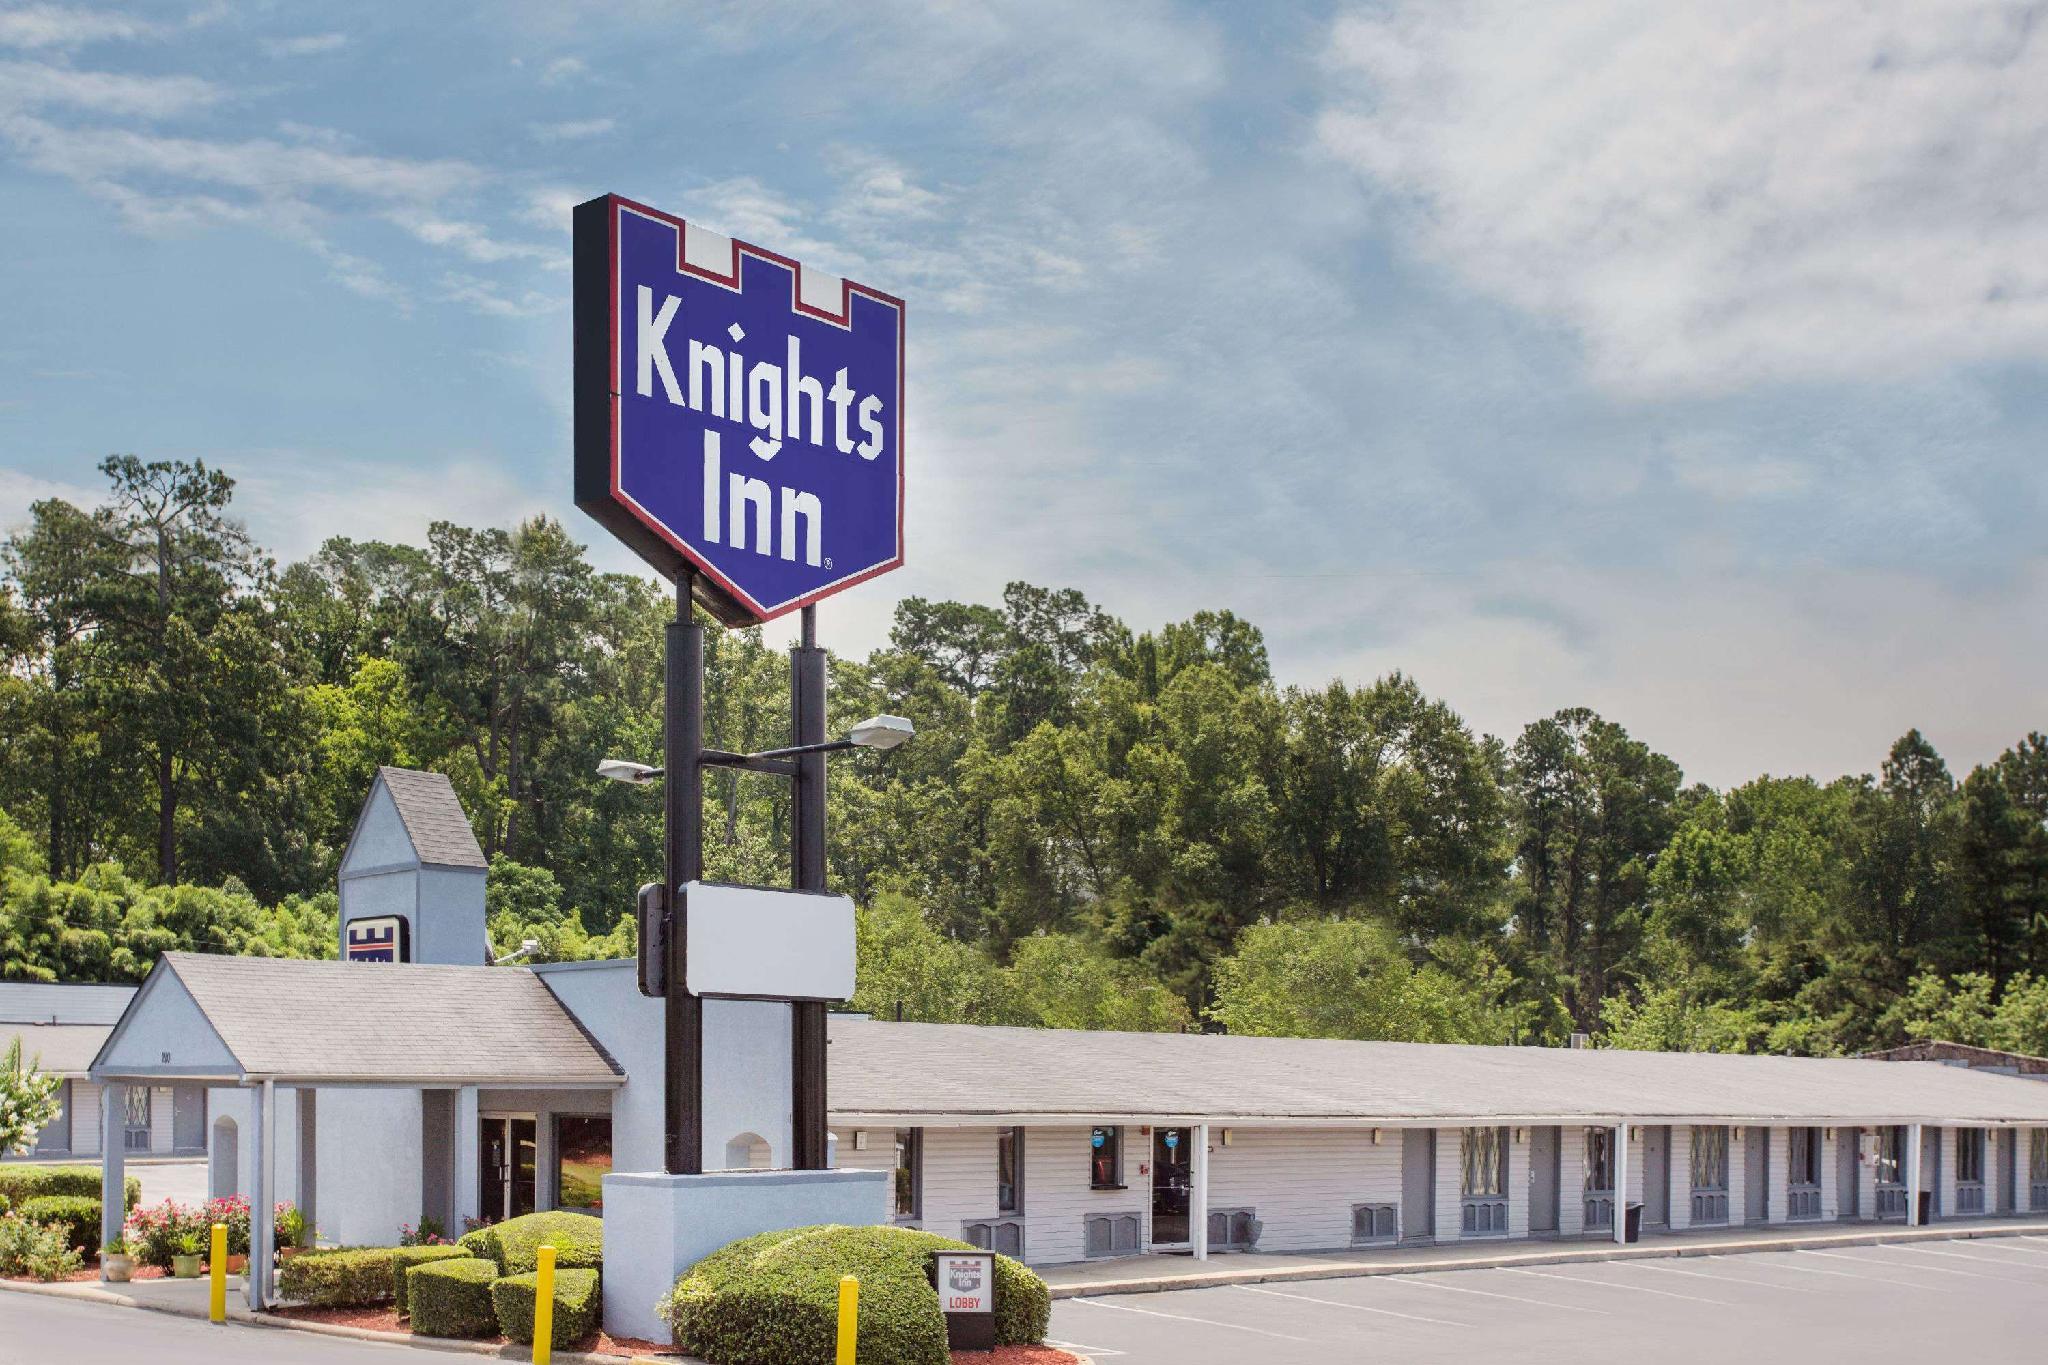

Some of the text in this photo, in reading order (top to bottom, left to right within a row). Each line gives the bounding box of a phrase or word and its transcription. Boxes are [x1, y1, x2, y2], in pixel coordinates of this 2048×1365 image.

[637, 284, 884, 461] Knights
[703, 428, 822, 568] Inn
[950, 1268, 982, 1279] Knights
[959, 1279, 972, 1287] Inn
[949, 1297, 980, 1308] LOBBY
